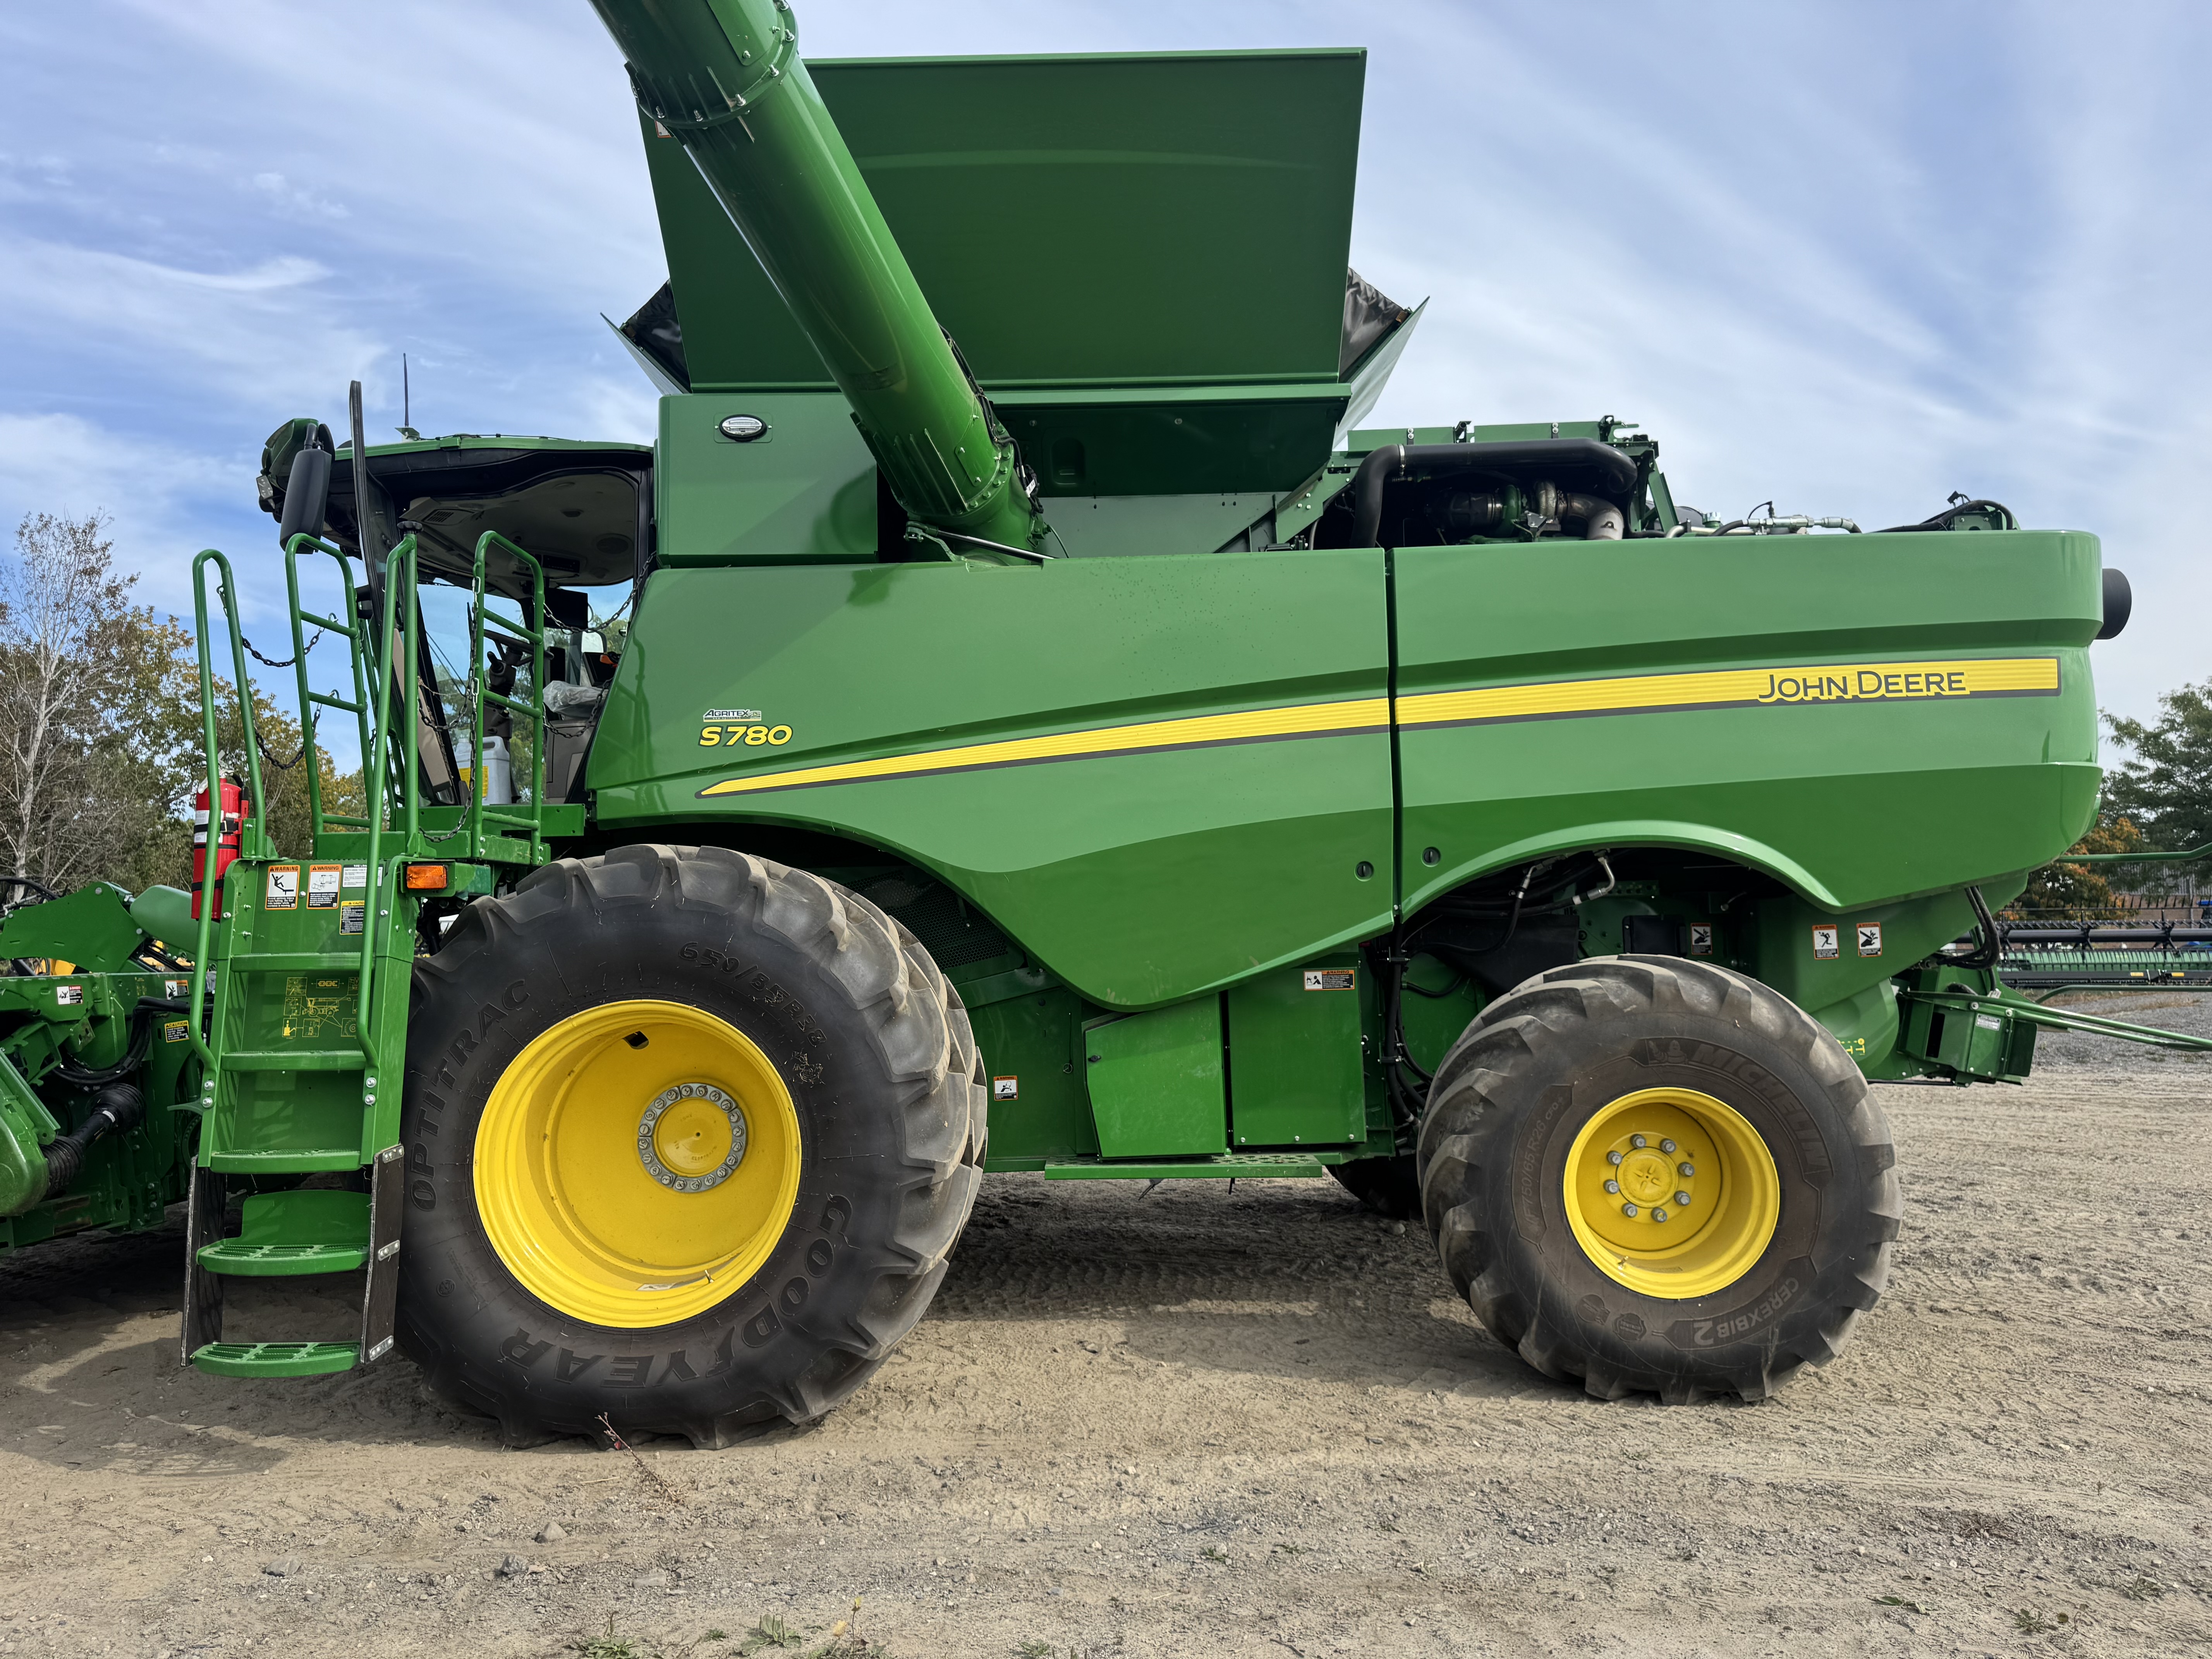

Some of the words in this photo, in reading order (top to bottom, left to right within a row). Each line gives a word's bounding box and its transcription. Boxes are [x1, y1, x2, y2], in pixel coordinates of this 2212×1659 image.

[1758, 674, 1848, 698] JOHN
[1857, 671, 1966, 694] DEERE
[699, 725, 793, 746] S780
[410, 979, 530, 1211] OPTITRAC
[1692, 1043, 1831, 1170] MICHELIN
[500, 1194, 853, 1388] GOODYEAR
[1716, 1277, 1799, 1338] CEREXBIB
[1693, 1321, 1714, 1346] 2
